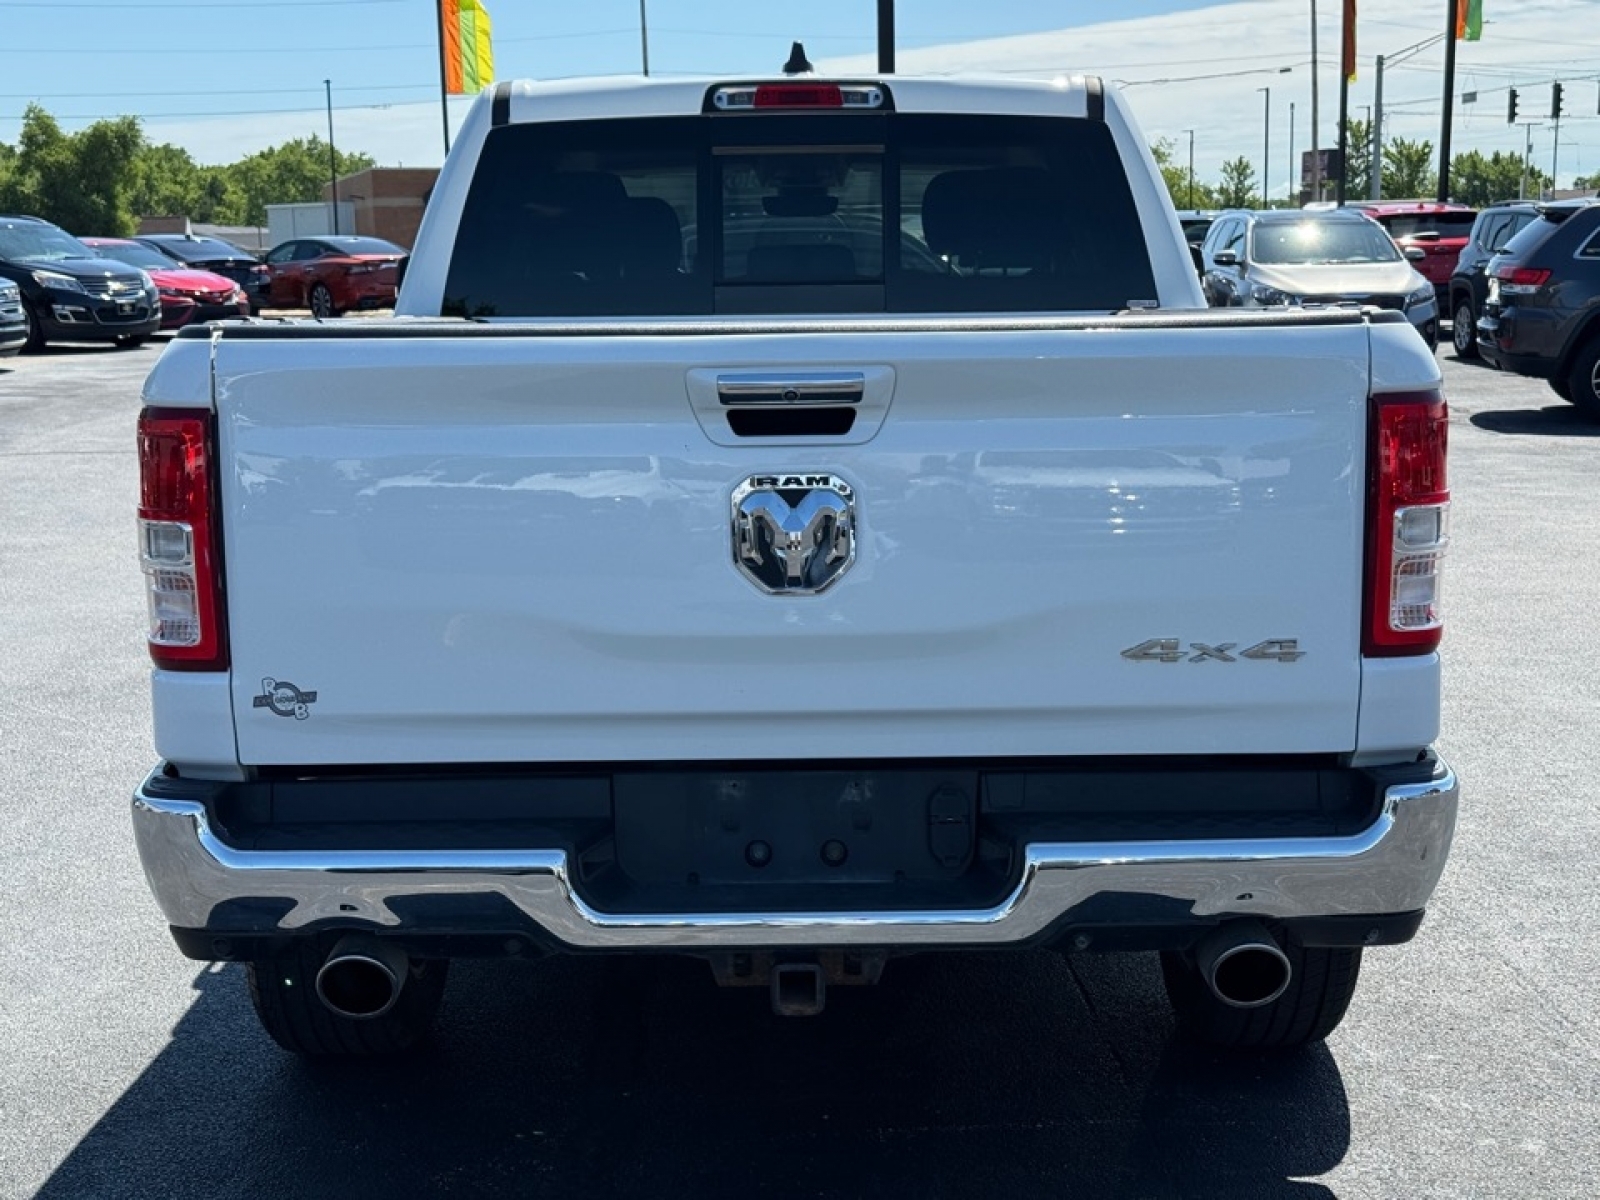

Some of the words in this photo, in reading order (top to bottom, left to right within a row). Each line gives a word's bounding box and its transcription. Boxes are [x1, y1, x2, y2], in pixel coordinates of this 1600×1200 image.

[756, 476, 830, 487] RAM
[1120, 638, 1307, 663] 4x4
[295, 703, 310, 720] B
